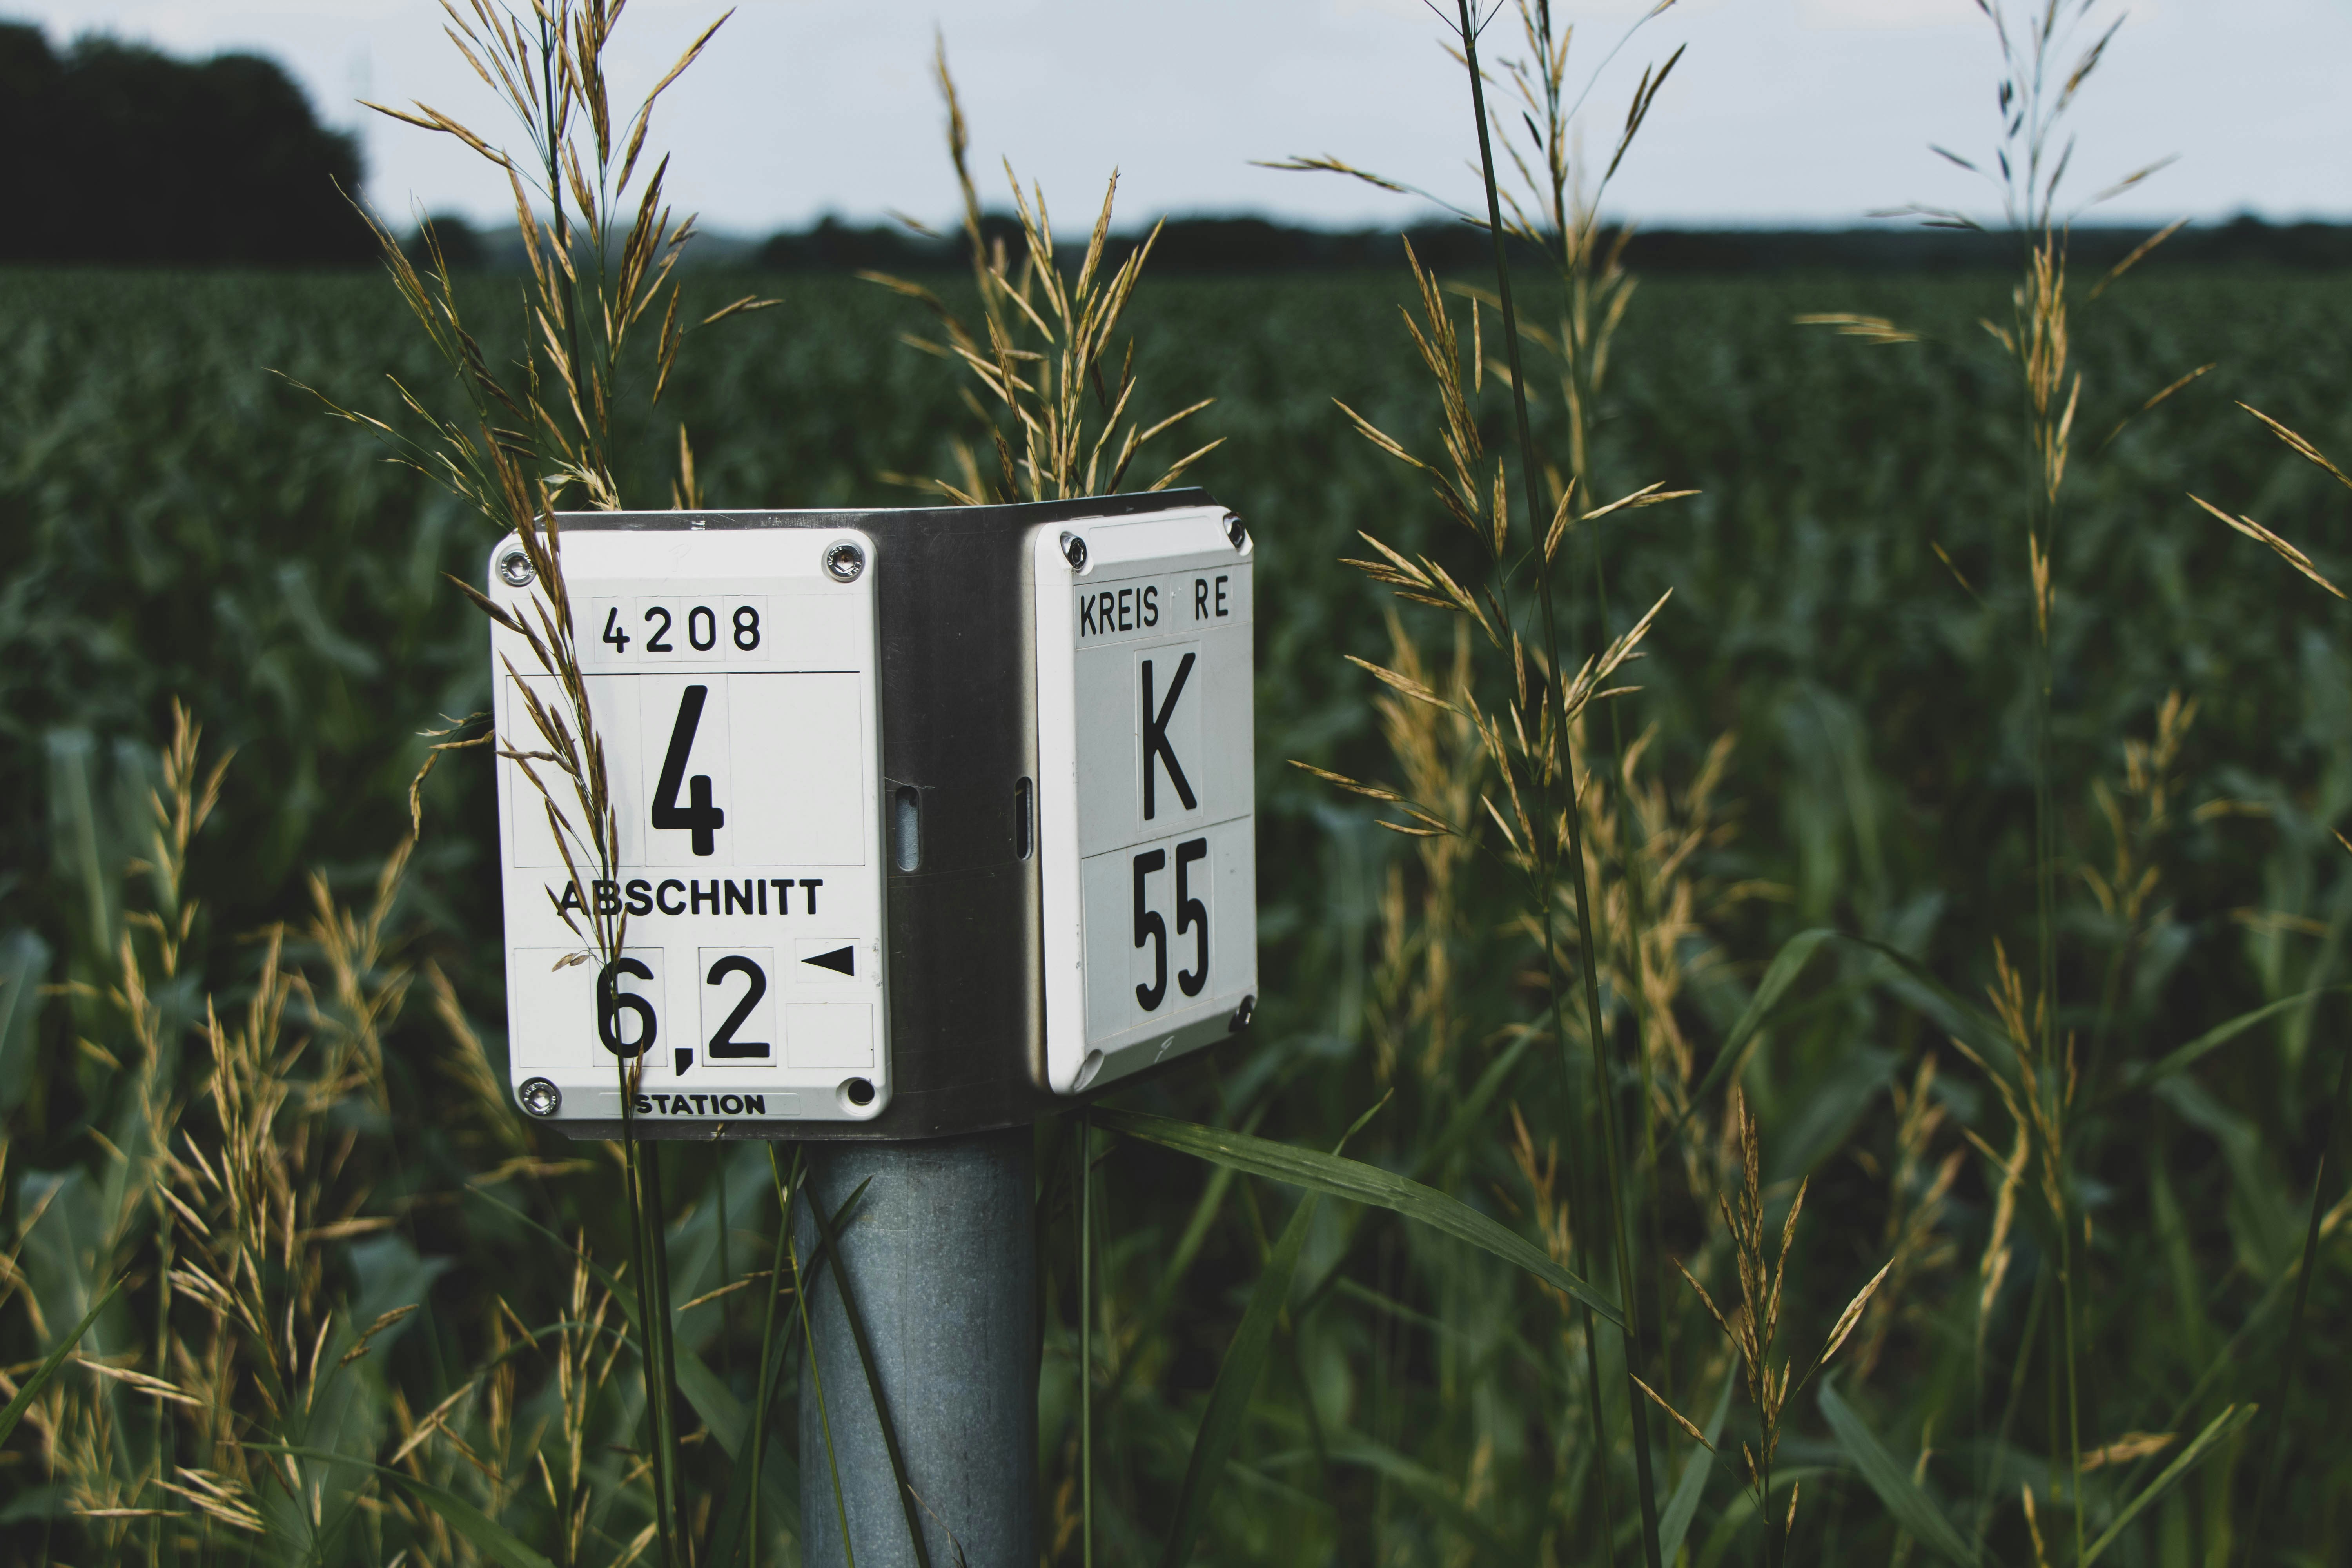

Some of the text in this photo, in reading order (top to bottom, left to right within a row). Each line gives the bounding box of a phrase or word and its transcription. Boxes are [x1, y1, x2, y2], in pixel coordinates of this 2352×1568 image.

[603, 606, 760, 653] 4208
[1081, 575, 1229, 637] KREIS RE
[652, 685, 724, 856] 4
[1142, 652, 1197, 820] K
[557, 879, 823, 916] ABSCHNITT
[1133, 837, 1209, 1011] 55
[597, 955, 771, 1076] 6,2
[635, 1094, 766, 1115] STATION
